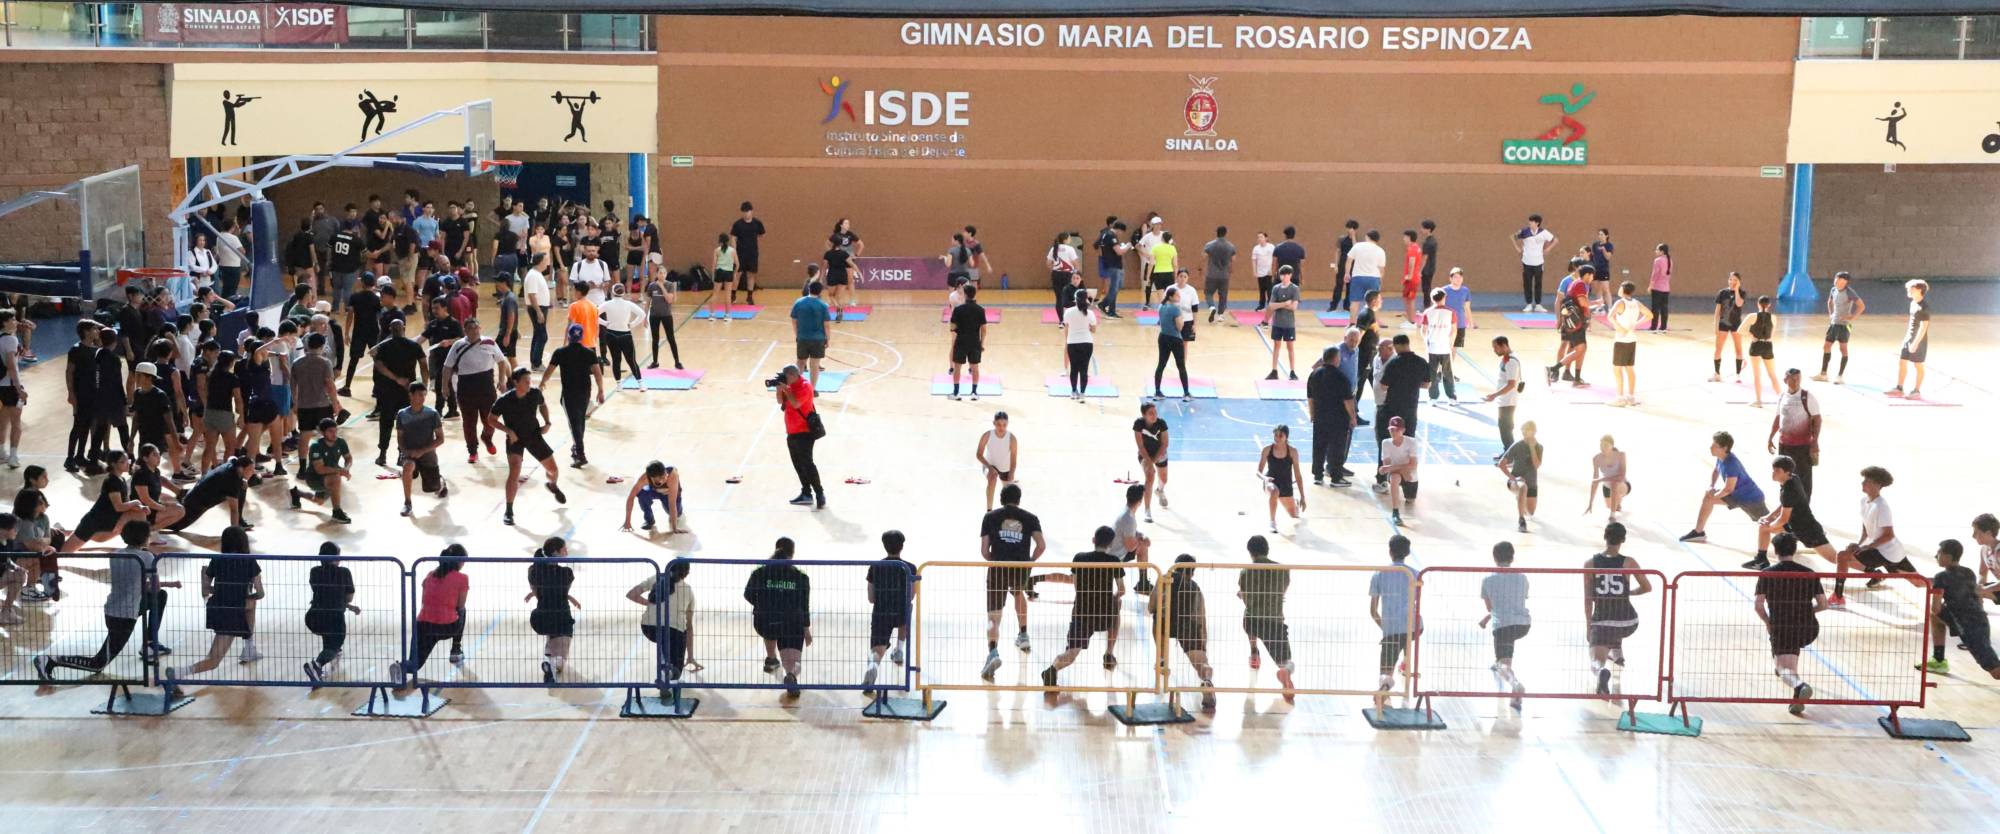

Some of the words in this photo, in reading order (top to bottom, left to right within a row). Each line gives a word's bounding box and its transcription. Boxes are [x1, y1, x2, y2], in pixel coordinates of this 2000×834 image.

[184, 8, 260, 24] SINALOA
[292, 8, 334, 26] ISDE
[901, 22, 1045, 47] GIMNASIO
[1058, 24, 1153, 48] MARIA
[1167, 25, 1223, 49] DEL
[1235, 25, 1369, 49] ROSARIO
[1382, 26, 1532, 50] ESPINOZA
[864, 90, 970, 126] ISDE
[1165, 138, 1239, 151] SINALOA
[1504, 145, 1585, 162] CONADE
[335, 241, 350, 255] 09
[880, 269, 912, 281] ISDE
[1595, 573, 1624, 595] 35
